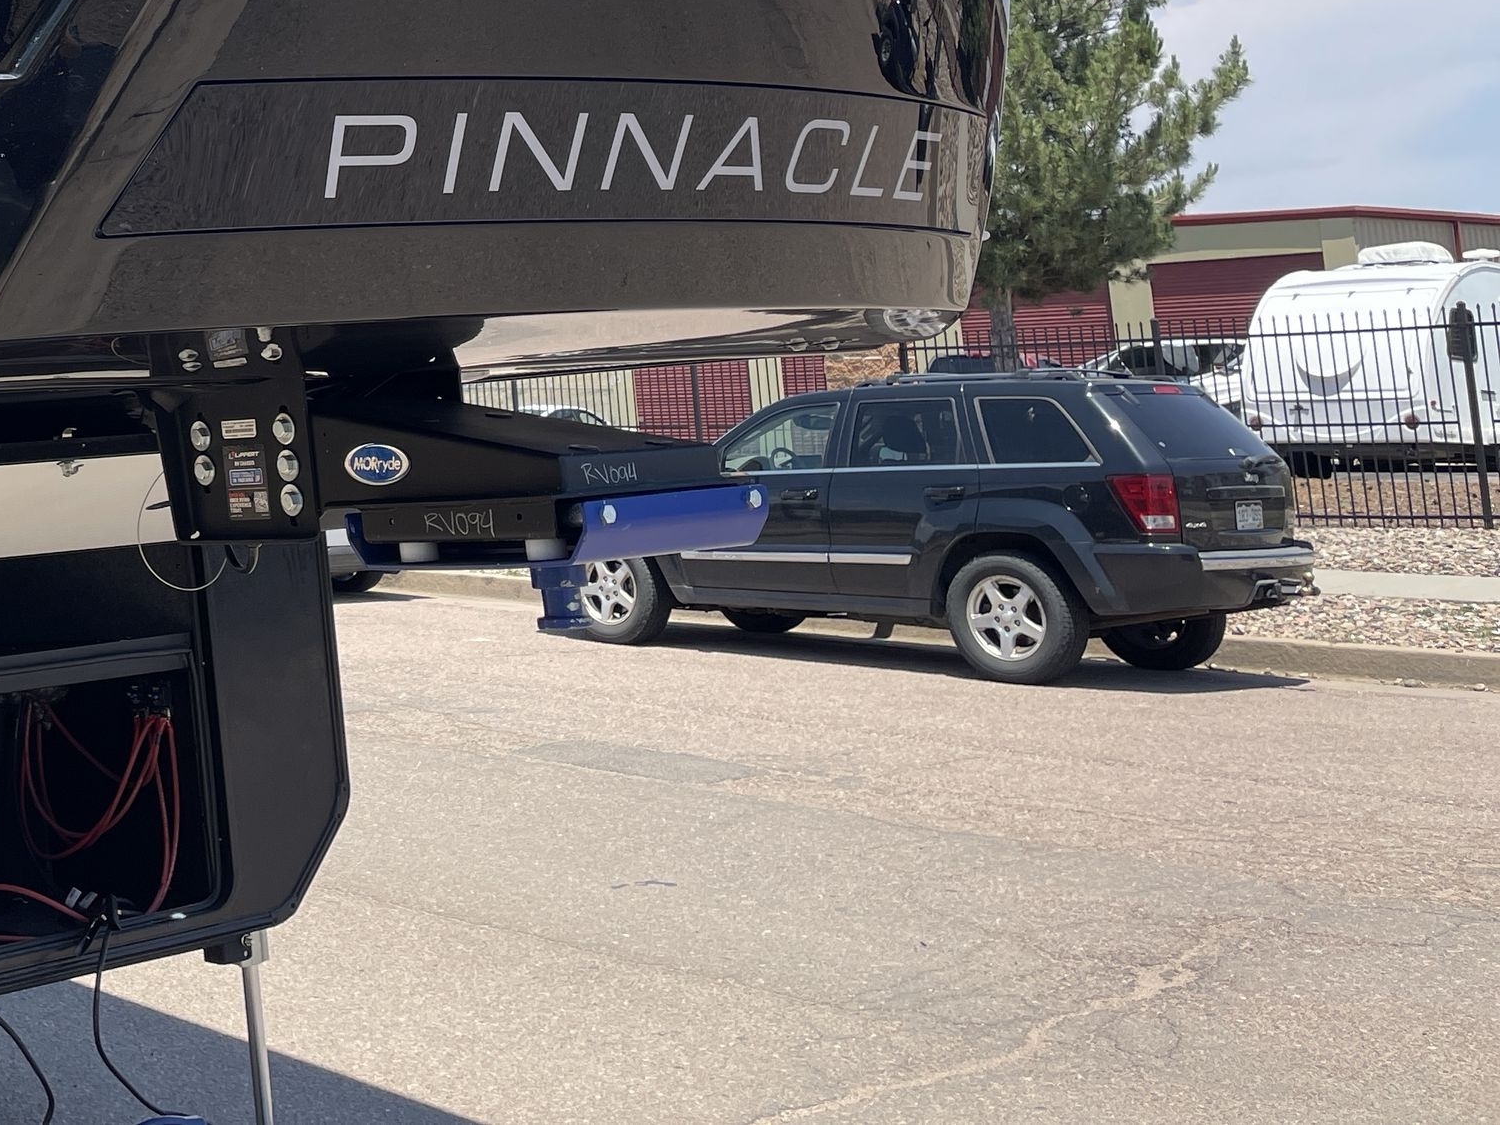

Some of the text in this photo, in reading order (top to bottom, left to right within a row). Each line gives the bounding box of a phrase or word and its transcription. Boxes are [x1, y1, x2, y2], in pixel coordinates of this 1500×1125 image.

[324, 112, 942, 202] PINNACLE
[352, 455, 402, 474] MORryde
[581, 462, 638, 485] RV094
[424, 509, 495, 539] RV094
